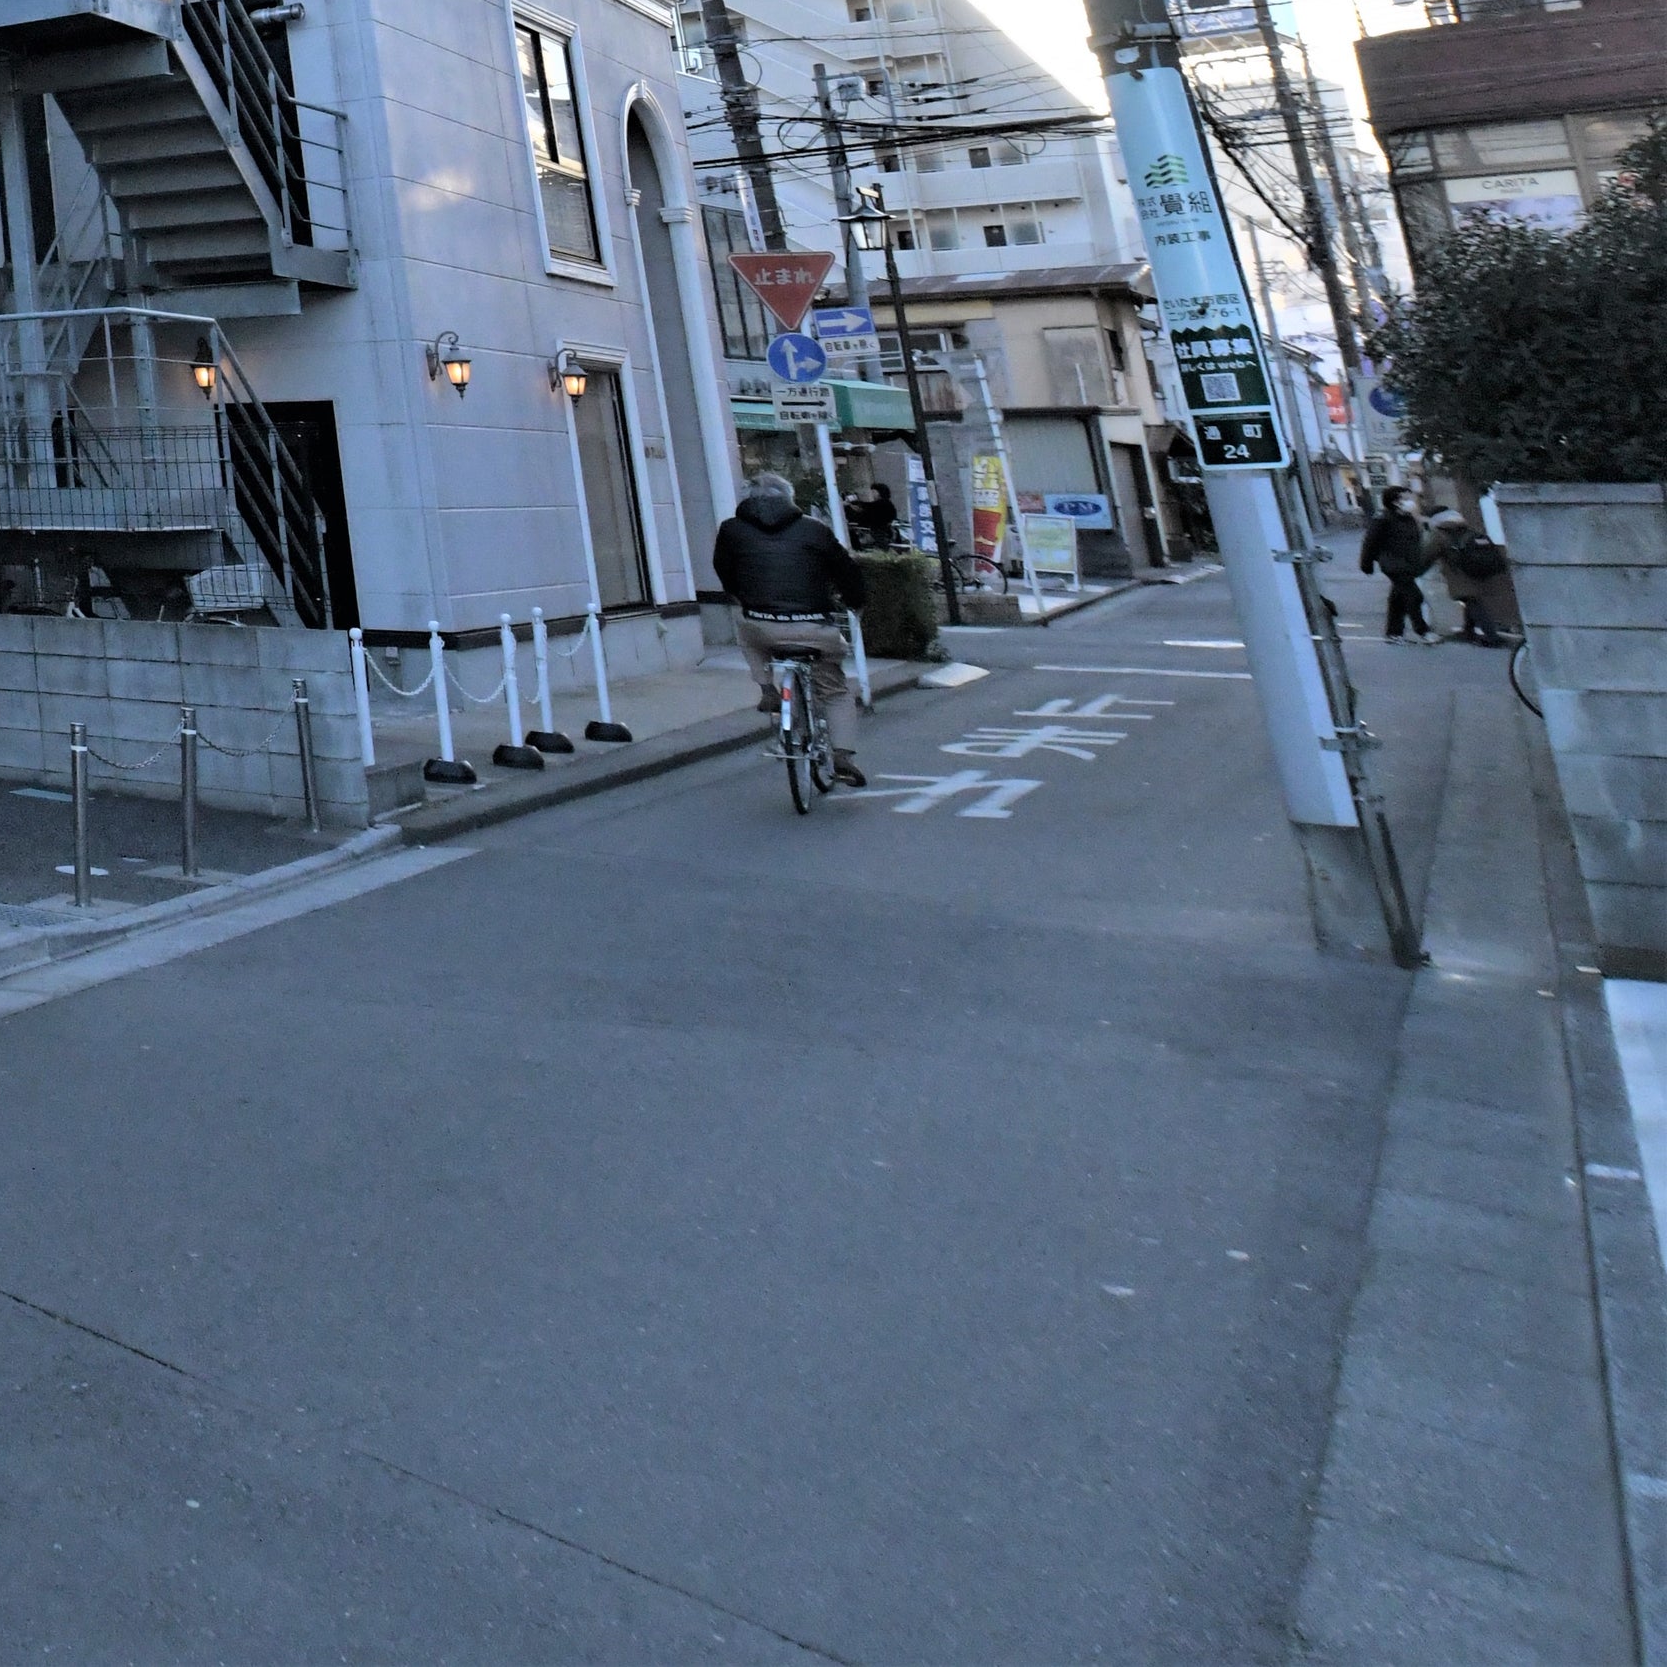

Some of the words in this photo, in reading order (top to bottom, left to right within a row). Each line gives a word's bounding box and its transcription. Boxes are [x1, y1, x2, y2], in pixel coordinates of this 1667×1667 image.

[1482, 177, 1539, 190] CARITA
[1154, 230, 1211, 246] 内装工事
[754, 267, 815, 285] 止まれ
[1223, 444, 1251, 459] 24
